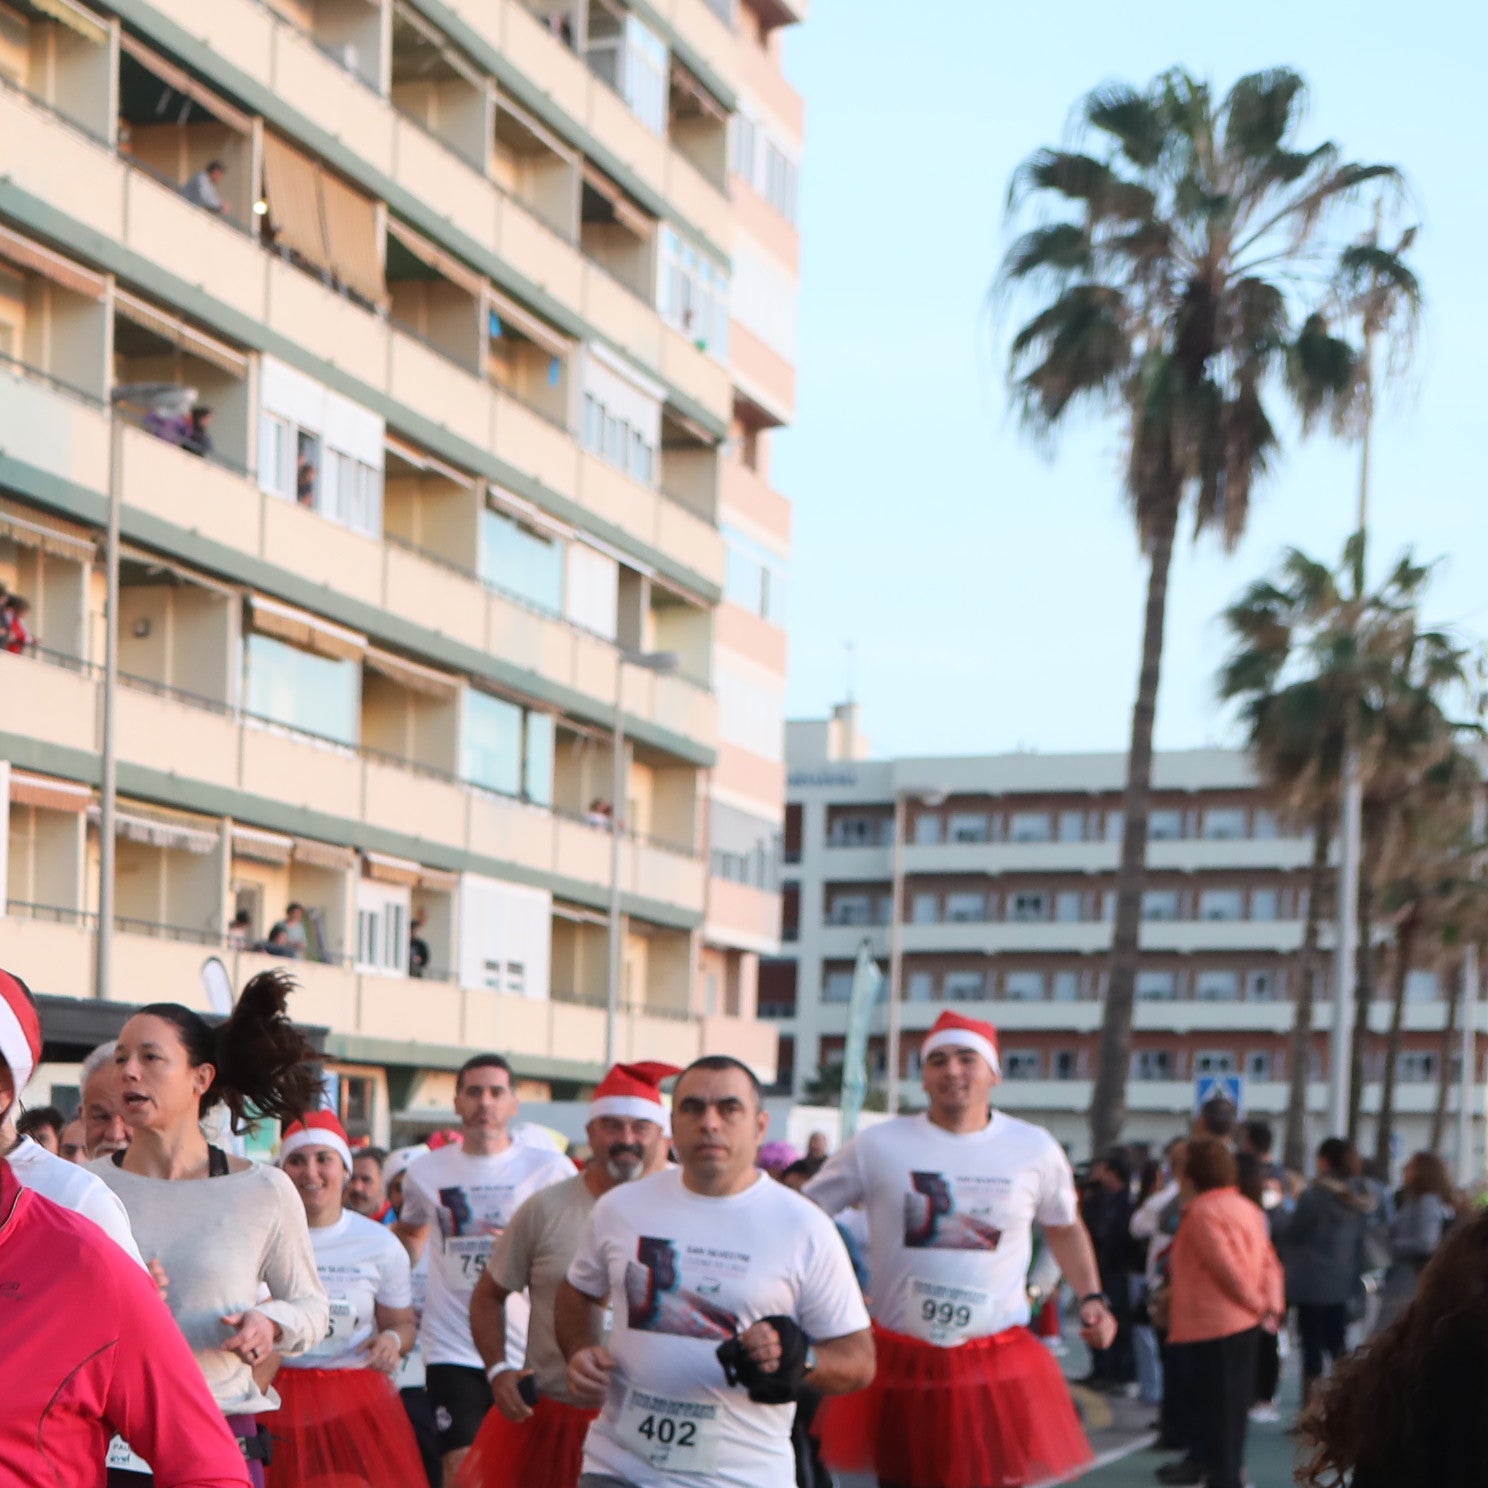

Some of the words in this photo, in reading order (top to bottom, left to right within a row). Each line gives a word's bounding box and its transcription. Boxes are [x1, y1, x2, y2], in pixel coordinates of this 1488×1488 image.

[460, 1253, 488, 1273] 75
[921, 1299, 971, 1328] 999
[637, 1415, 697, 1448] 402
